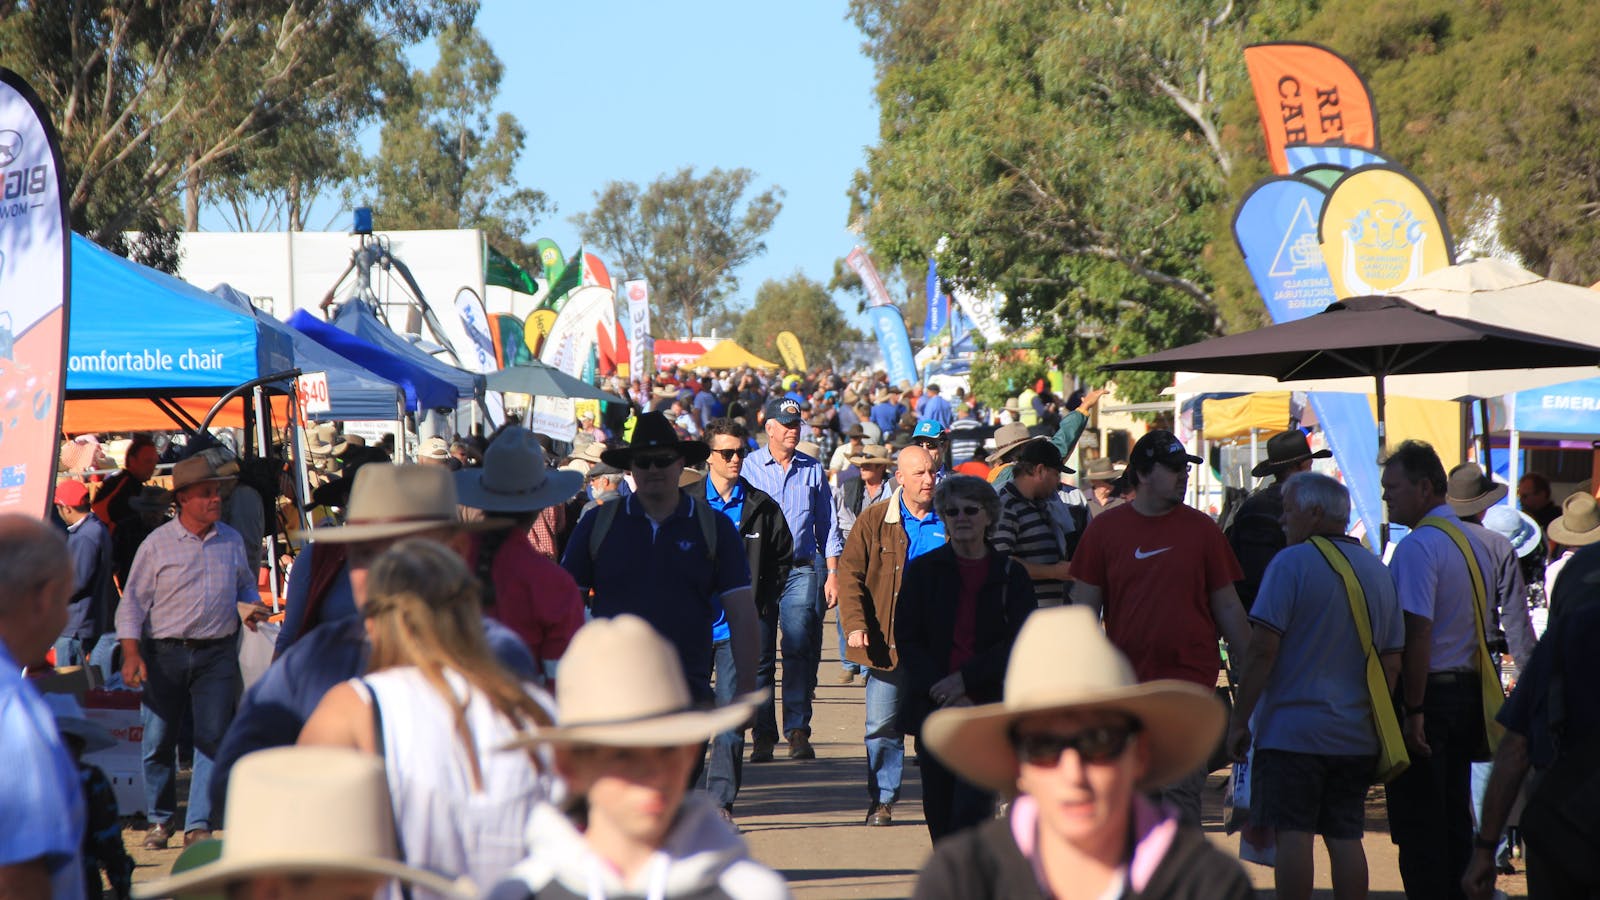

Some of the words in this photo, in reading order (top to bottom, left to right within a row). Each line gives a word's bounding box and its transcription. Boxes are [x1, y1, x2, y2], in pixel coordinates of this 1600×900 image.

[67, 348, 173, 372] omfortable
[179, 348, 224, 370] chair
[300, 380, 327, 406] $40
